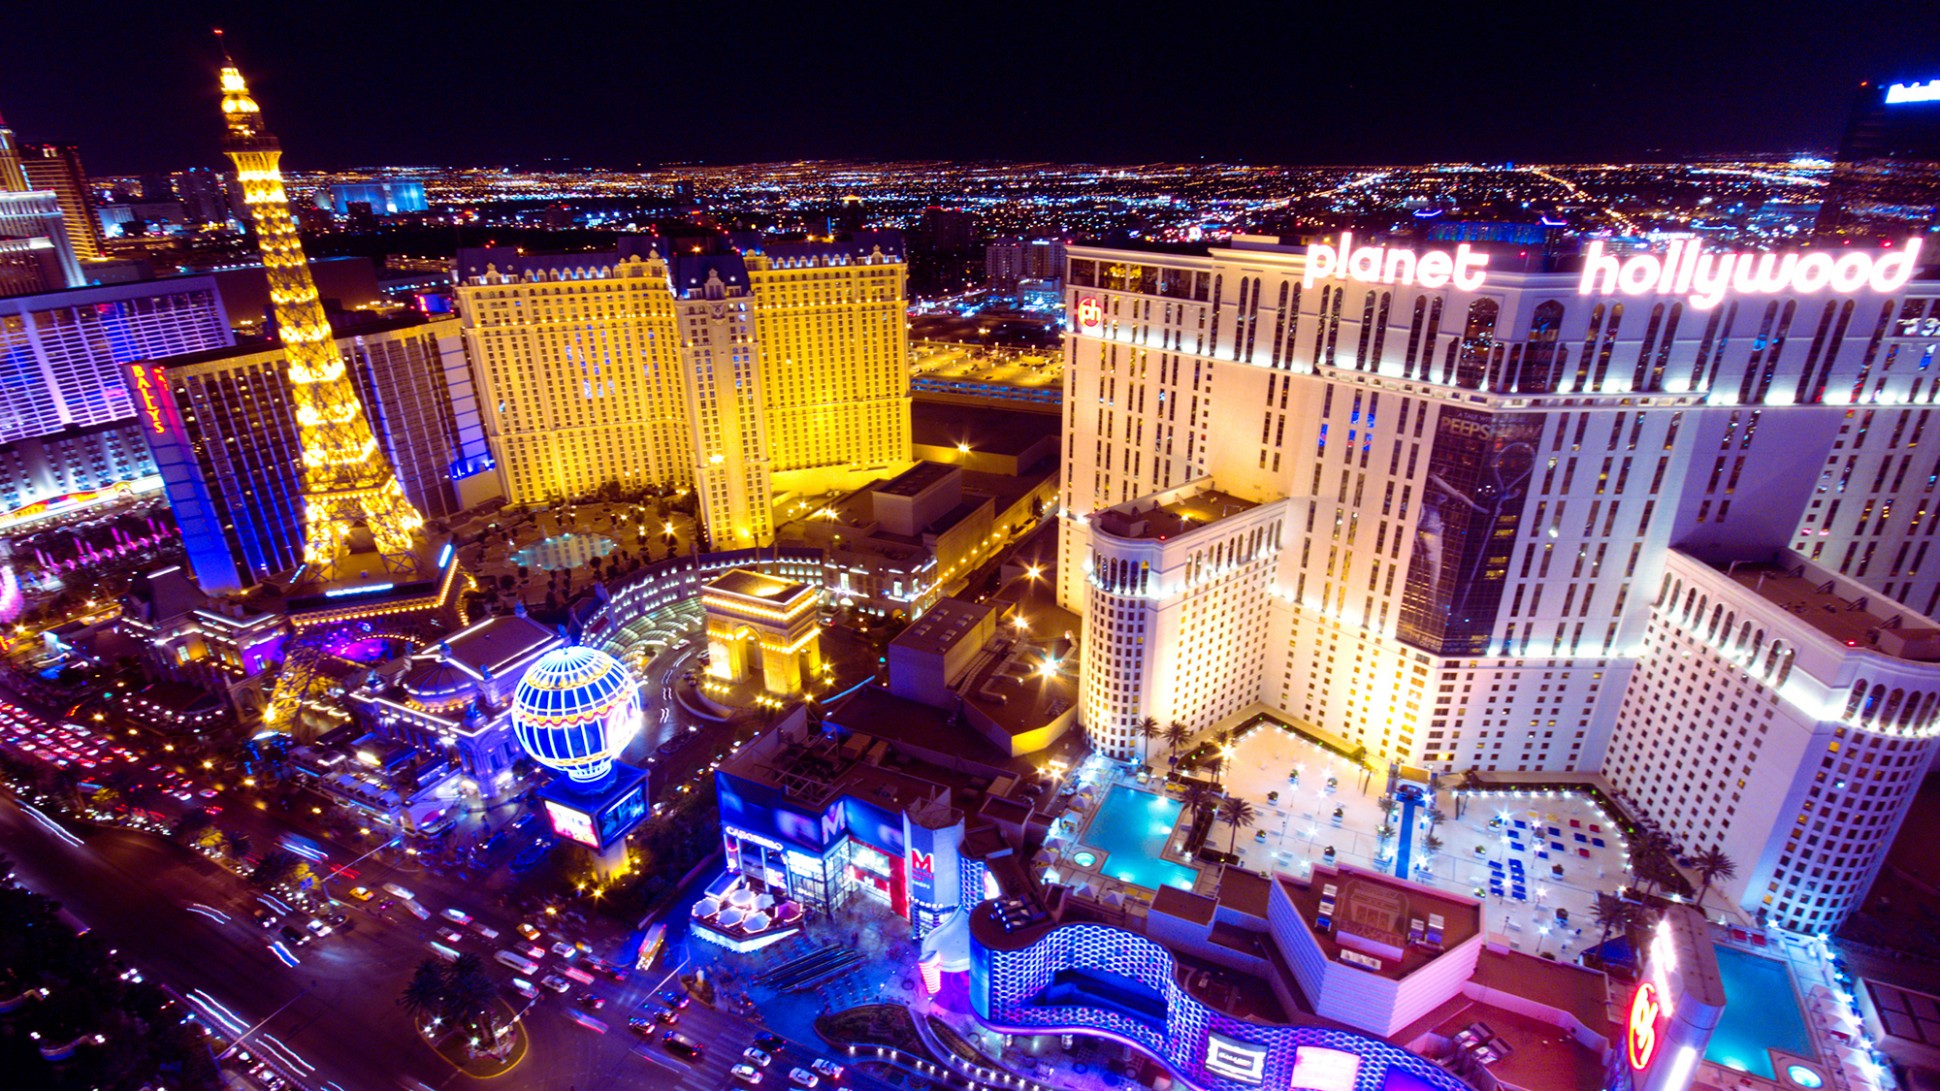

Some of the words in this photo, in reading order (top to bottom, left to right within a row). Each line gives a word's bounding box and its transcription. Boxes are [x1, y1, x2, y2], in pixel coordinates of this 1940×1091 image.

[1303, 232, 1489, 291] planet
[1579, 237, 1923, 310] hollywood
[1079, 298, 1102, 325] ph
[821, 801, 845, 845] M
[911, 848, 934, 874] M
